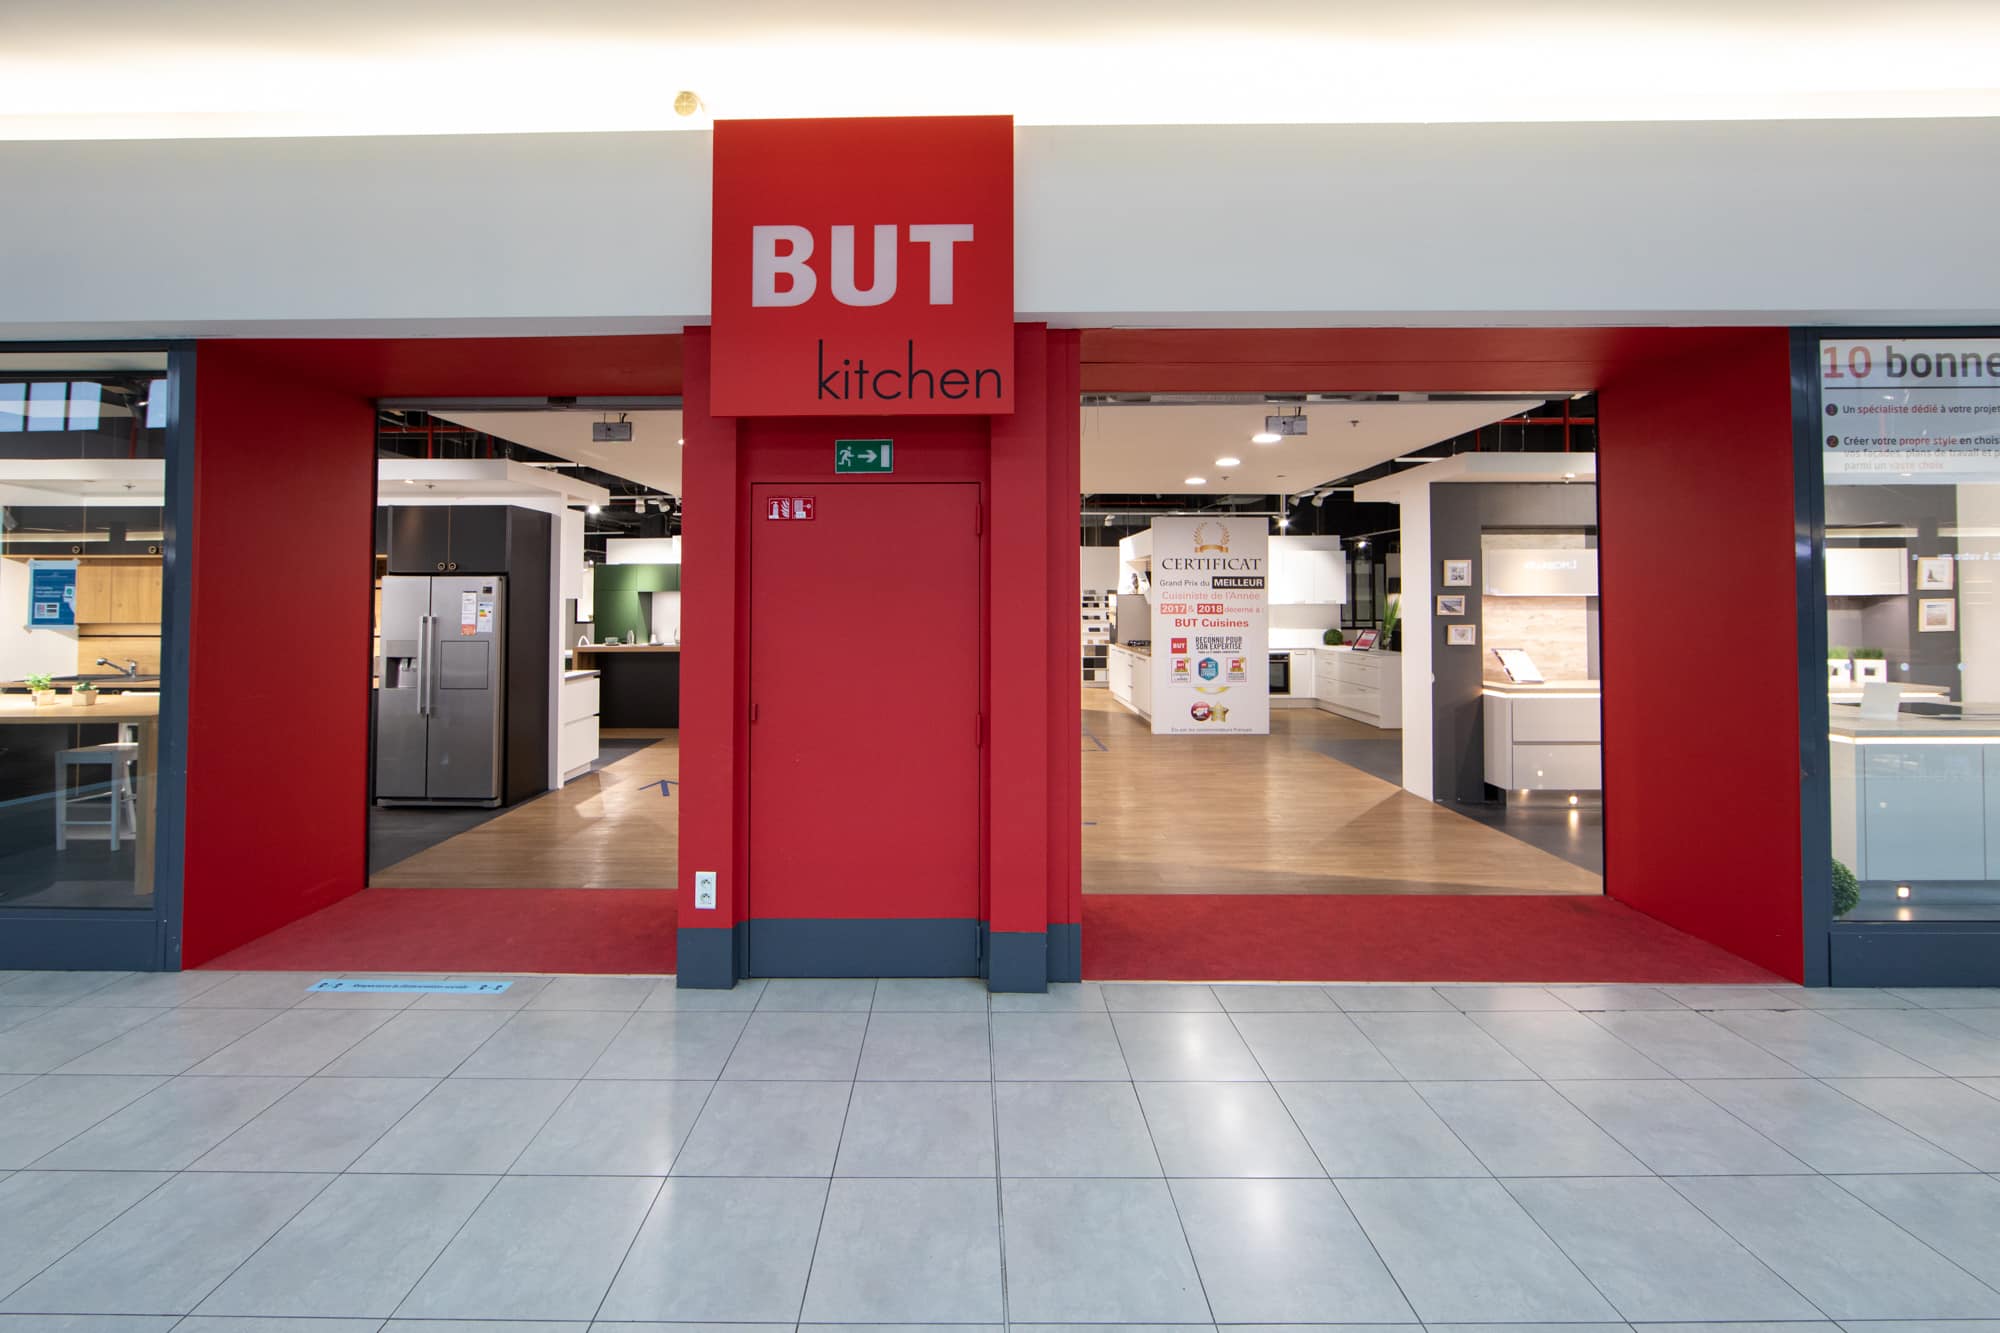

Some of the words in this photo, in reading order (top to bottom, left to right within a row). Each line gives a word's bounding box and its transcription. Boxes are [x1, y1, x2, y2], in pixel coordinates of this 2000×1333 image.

[752, 224, 974, 307] BUT
[1823, 346, 1872, 379] 10
[1886, 345, 2000, 378] bonne
[818, 339, 1002, 400] kitchen
[1843, 406, 1856, 414] Un
[1857, 404, 1908, 416] spécialiste
[1911, 404, 1938, 414] dédié
[1940, 404, 1946, 414] à
[1948, 406, 1972, 414] votre
[1843, 436, 1869, 445] Créer
[1872, 437, 1896, 445] votre
[1899, 438, 1930, 447] propre
[1933, 436, 1957, 447] style
[1935, 448, 1946, 457] de
[1948, 448, 1979, 457] travail
[1981, 449, 1992, 457] et
[1844, 461, 1872, 471] parmi
[1162, 558, 1262, 570] CERTIFICAT
[1160, 579, 1182, 587] Grand
[1184, 579, 1198, 587] Prix
[1200, 579, 1210, 587] du
[1213, 578, 1264, 587] MEILLEUR
[1162, 591, 1208, 600] Cuisiniste
[1211, 591, 1223, 600] de
[1161, 605, 1186, 613] 2017
[1198, 605, 1223, 613] 2018
[1175, 618, 1197, 628] BUT
[1201, 618, 1249, 628] Cuisines
